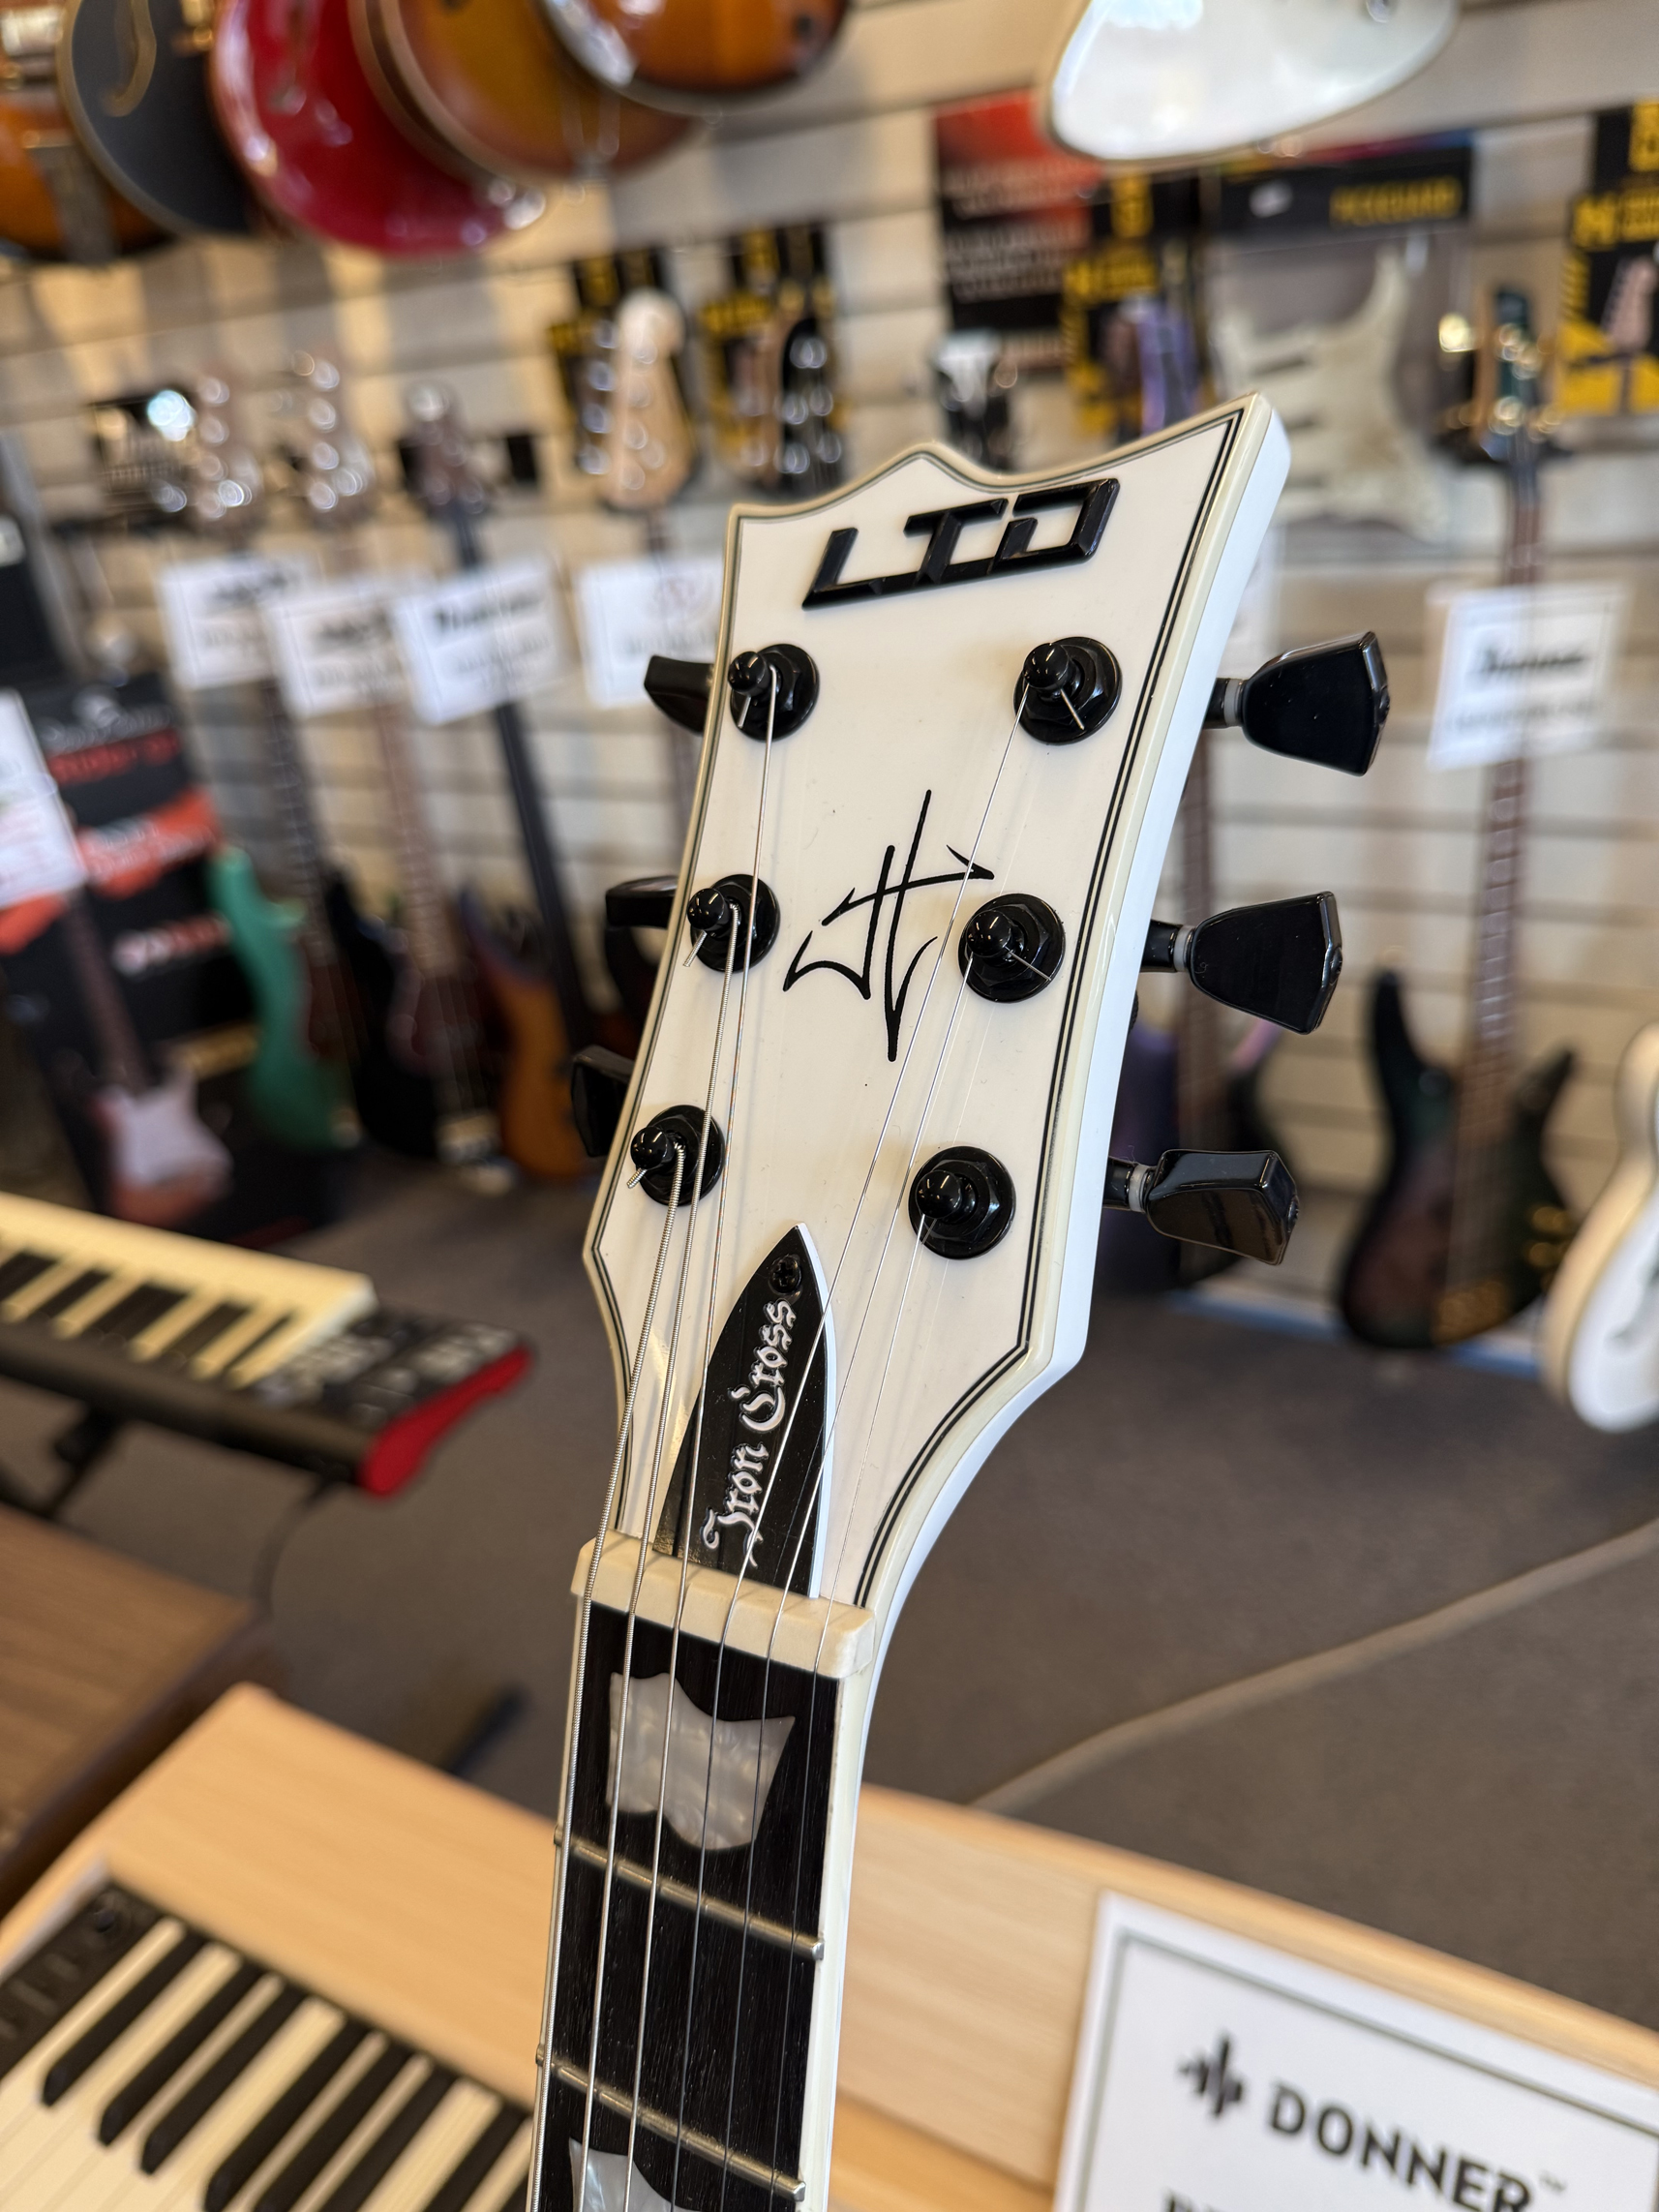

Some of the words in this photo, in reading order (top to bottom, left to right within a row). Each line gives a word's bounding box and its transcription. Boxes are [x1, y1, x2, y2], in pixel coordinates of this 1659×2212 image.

[801, 477, 1121, 611] LTD
[730, 1298, 797, 1433] Cross
[700, 1440, 769, 1568] Iron
[1269, 2081, 1532, 2212] DONNER
